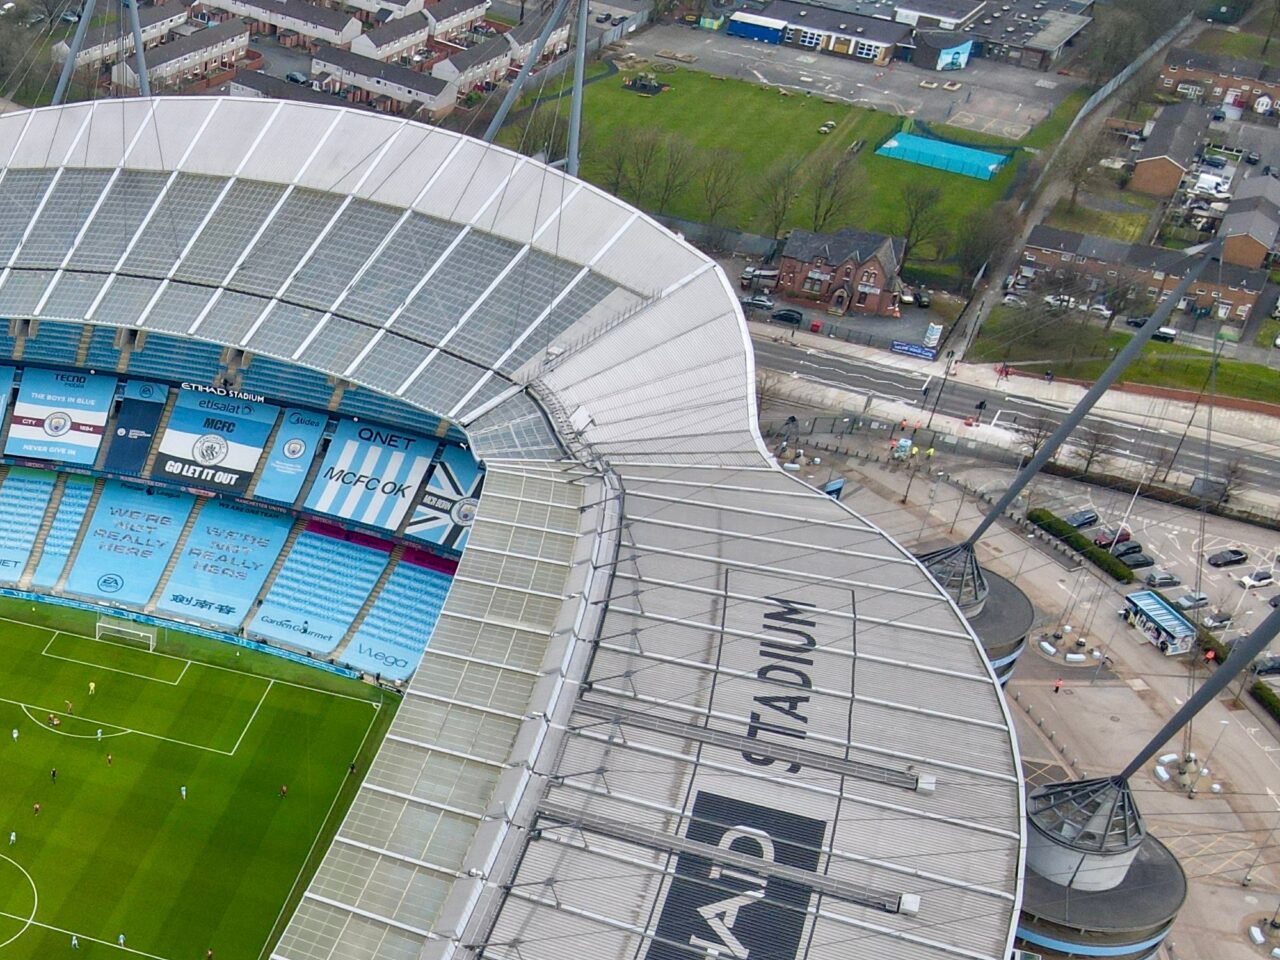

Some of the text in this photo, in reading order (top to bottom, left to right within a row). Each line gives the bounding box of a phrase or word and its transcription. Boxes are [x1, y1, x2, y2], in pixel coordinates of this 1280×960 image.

[76, 397, 96, 405] BLUE
[181, 382, 265, 403] ETIHAD STADIUM
[198, 400, 241, 414] etisalat
[203, 417, 236, 433] MCFC
[22, 443, 48, 452] NEVER
[48, 446, 67, 454] GIVE
[358, 427, 416, 450] QNET
[165, 460, 240, 486] GO LET IT OUT
[323, 466, 381, 492] MCFC
[381, 481, 413, 498] OK
[93, 528, 169, 549] REALLY
[187, 548, 264, 571] REALLY
[261, 615, 293, 630] Garden
